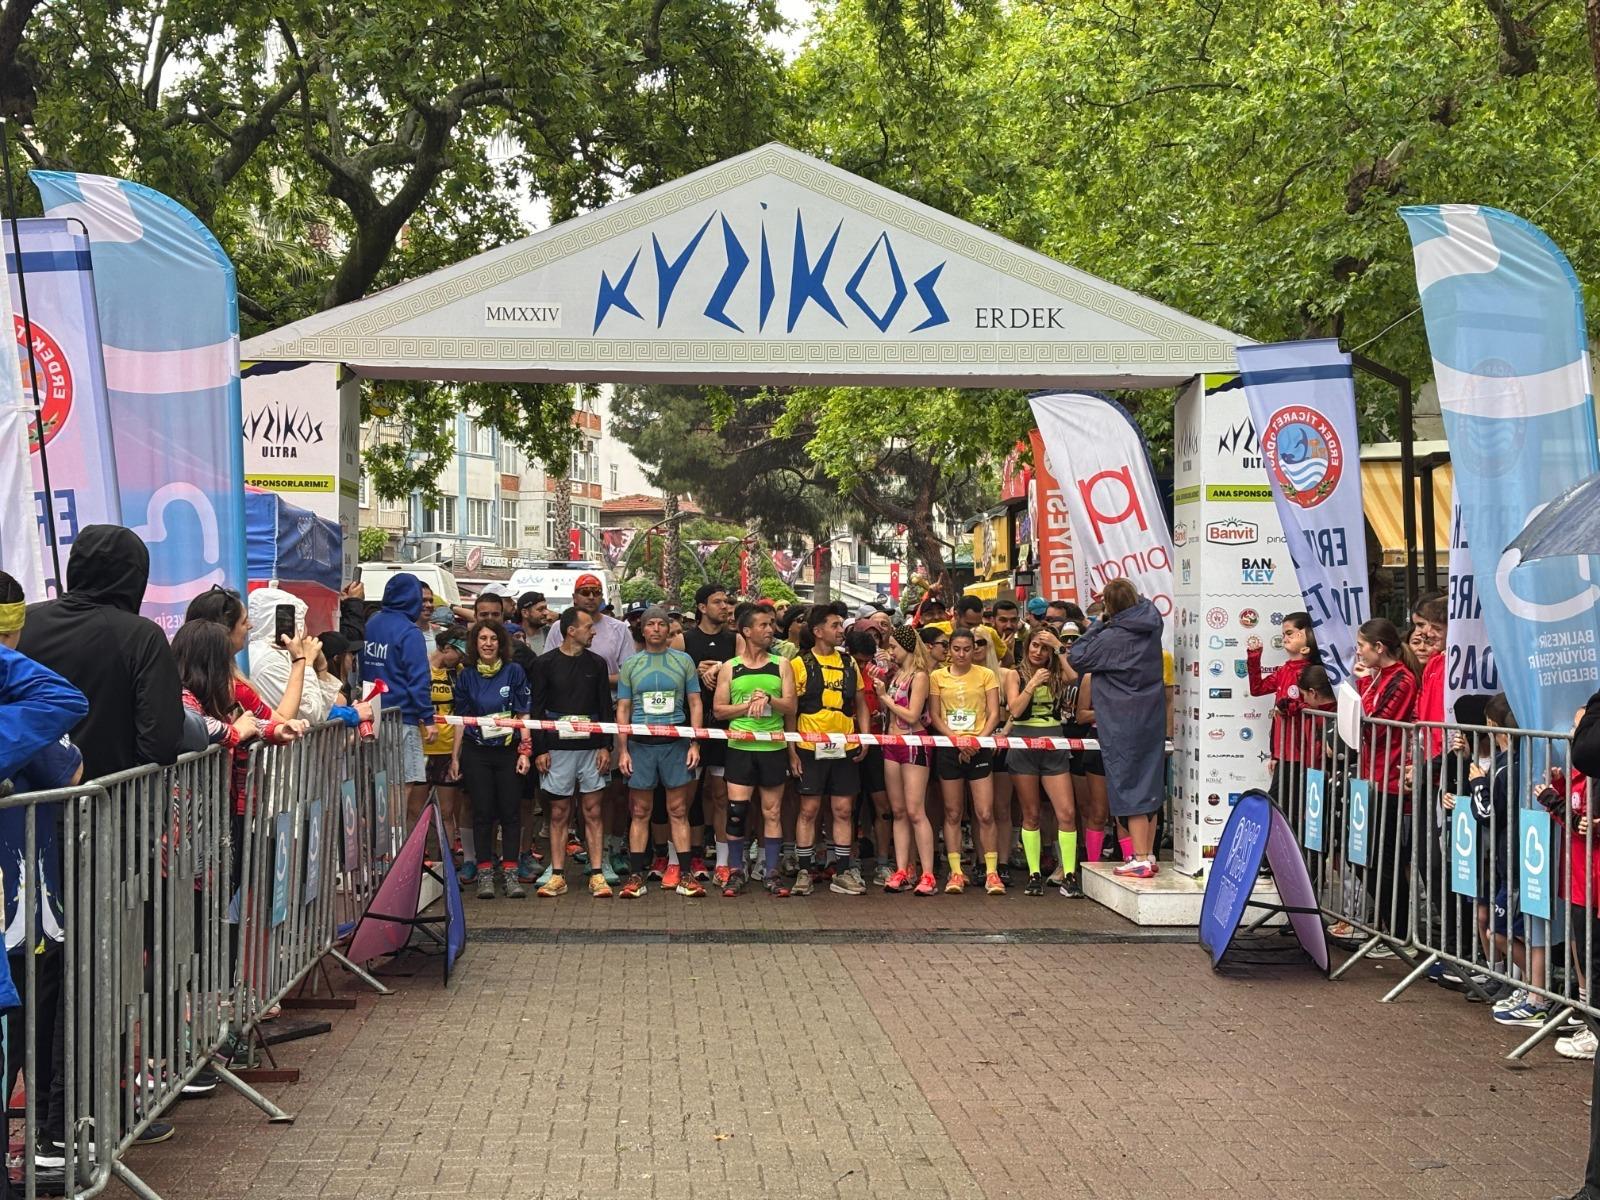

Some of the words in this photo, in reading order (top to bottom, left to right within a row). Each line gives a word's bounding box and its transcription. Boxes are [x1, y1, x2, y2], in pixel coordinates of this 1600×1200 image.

[486, 307, 560, 322] MMXXIV
[975, 308, 1065, 329] ERDEK
[261, 446, 297, 458] ULTRA
[1243, 457, 1266, 469] ULT
[251, 479, 329, 488] SPONSORLARIMIZ
[1210, 526, 1254, 539] Banvit
[1241, 558, 1272, 569] BAN
[651, 697, 667, 705] 202
